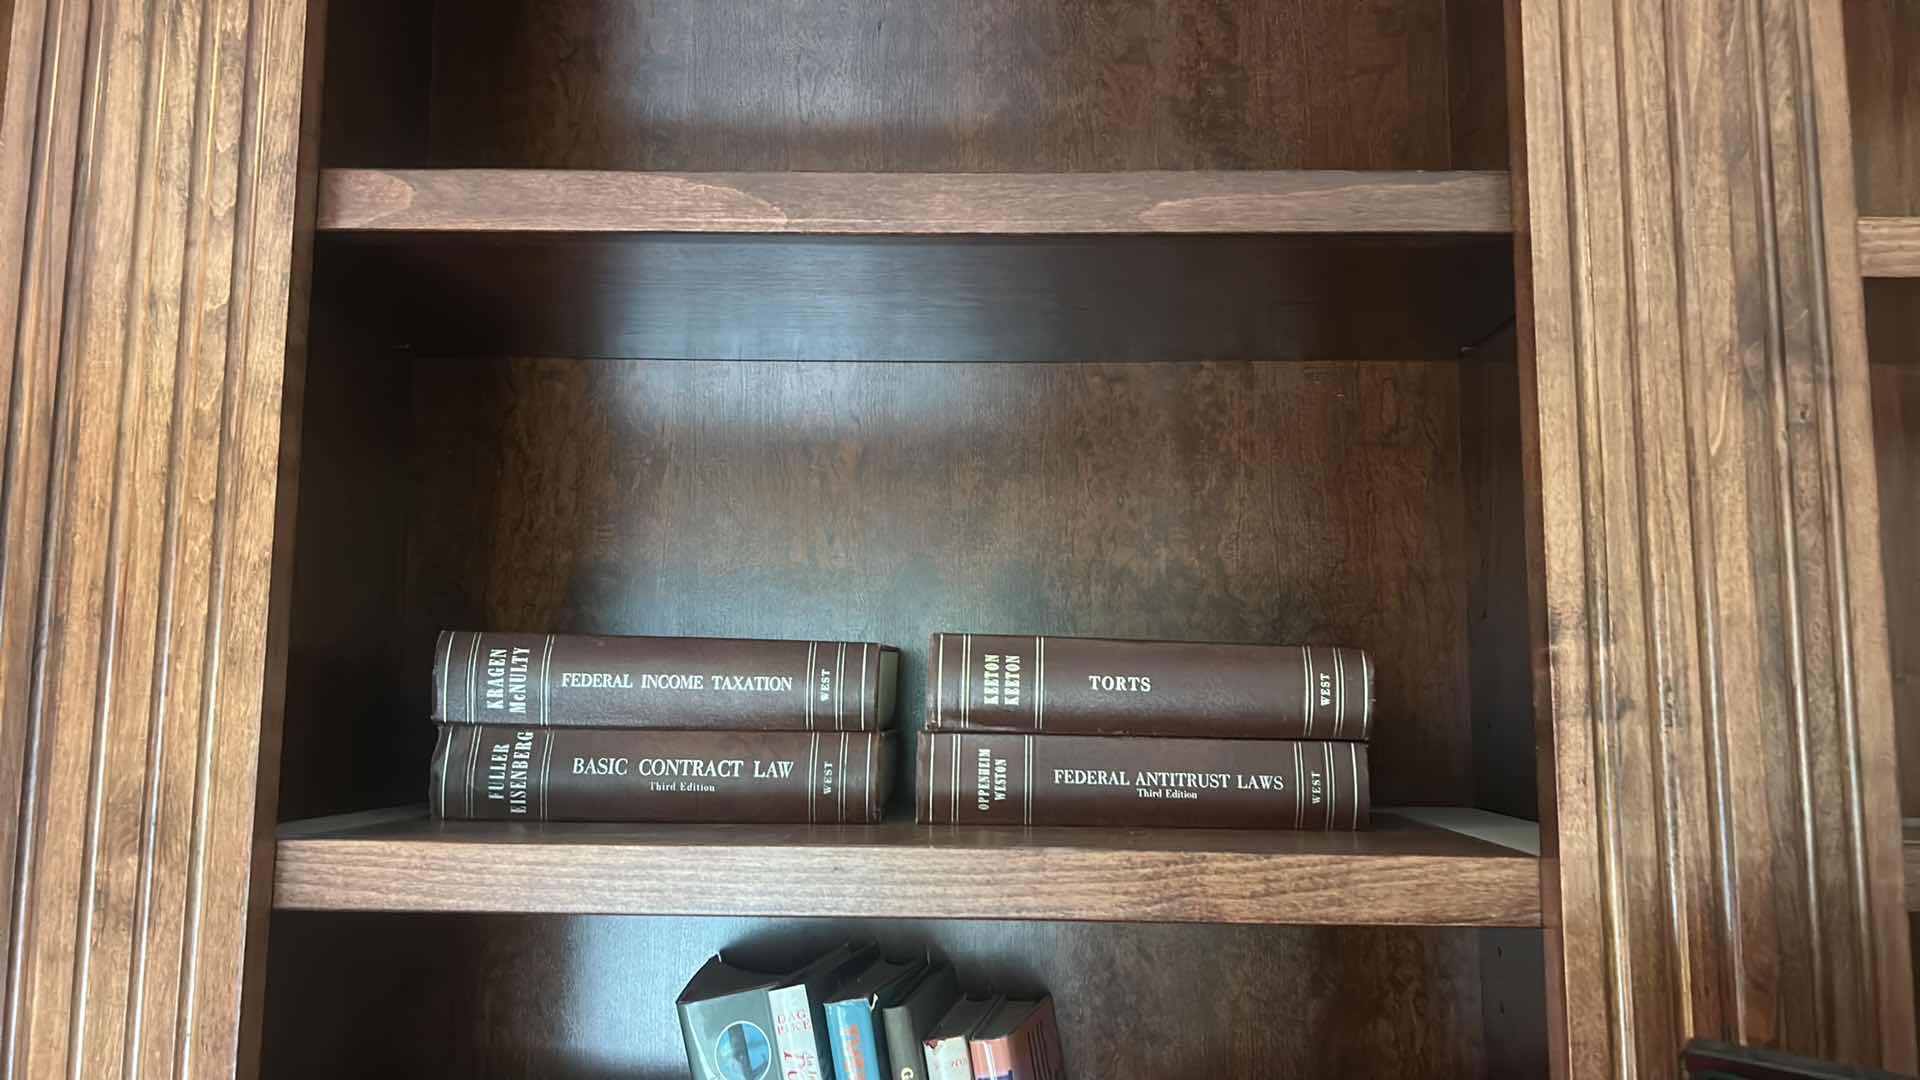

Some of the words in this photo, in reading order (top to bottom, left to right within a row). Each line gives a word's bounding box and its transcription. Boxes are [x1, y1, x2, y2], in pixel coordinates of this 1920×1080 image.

[486, 649, 507, 710] KRAGEN
[508, 647, 530, 714] McNULTY
[561, 672, 634, 689] FEDERAL
[640, 674, 704, 690] INCOME
[711, 675, 793, 692] TAXATION
[819, 668, 831, 702] WEST
[983, 654, 1000, 705] KEETON
[1003, 655, 1021, 706] KEETON
[1088, 675, 1151, 693] TORTS
[1319, 673, 1331, 706] WEST
[488, 743, 510, 799] FULLER
[509, 731, 534, 813] EISENBERG
[572, 757, 629, 776] BASIC
[638, 758, 744, 778] CONTRACT
[753, 760, 794, 779] LAW
[823, 761, 833, 795] WEST
[977, 748, 991, 810] OPPENHEIM
[994, 759, 1007, 801] WESTON
[1054, 769, 1130, 787] FEDERAL
[1135, 771, 1231, 790] ANTITRUST
[1237, 774, 1284, 790] LAWS
[650, 781, 676, 791] Third
[680, 781, 715, 792] Edition
[1136, 788, 1163, 798] Third
[1165, 788, 1198, 799] Edition
[1311, 772, 1321, 804] WEST
